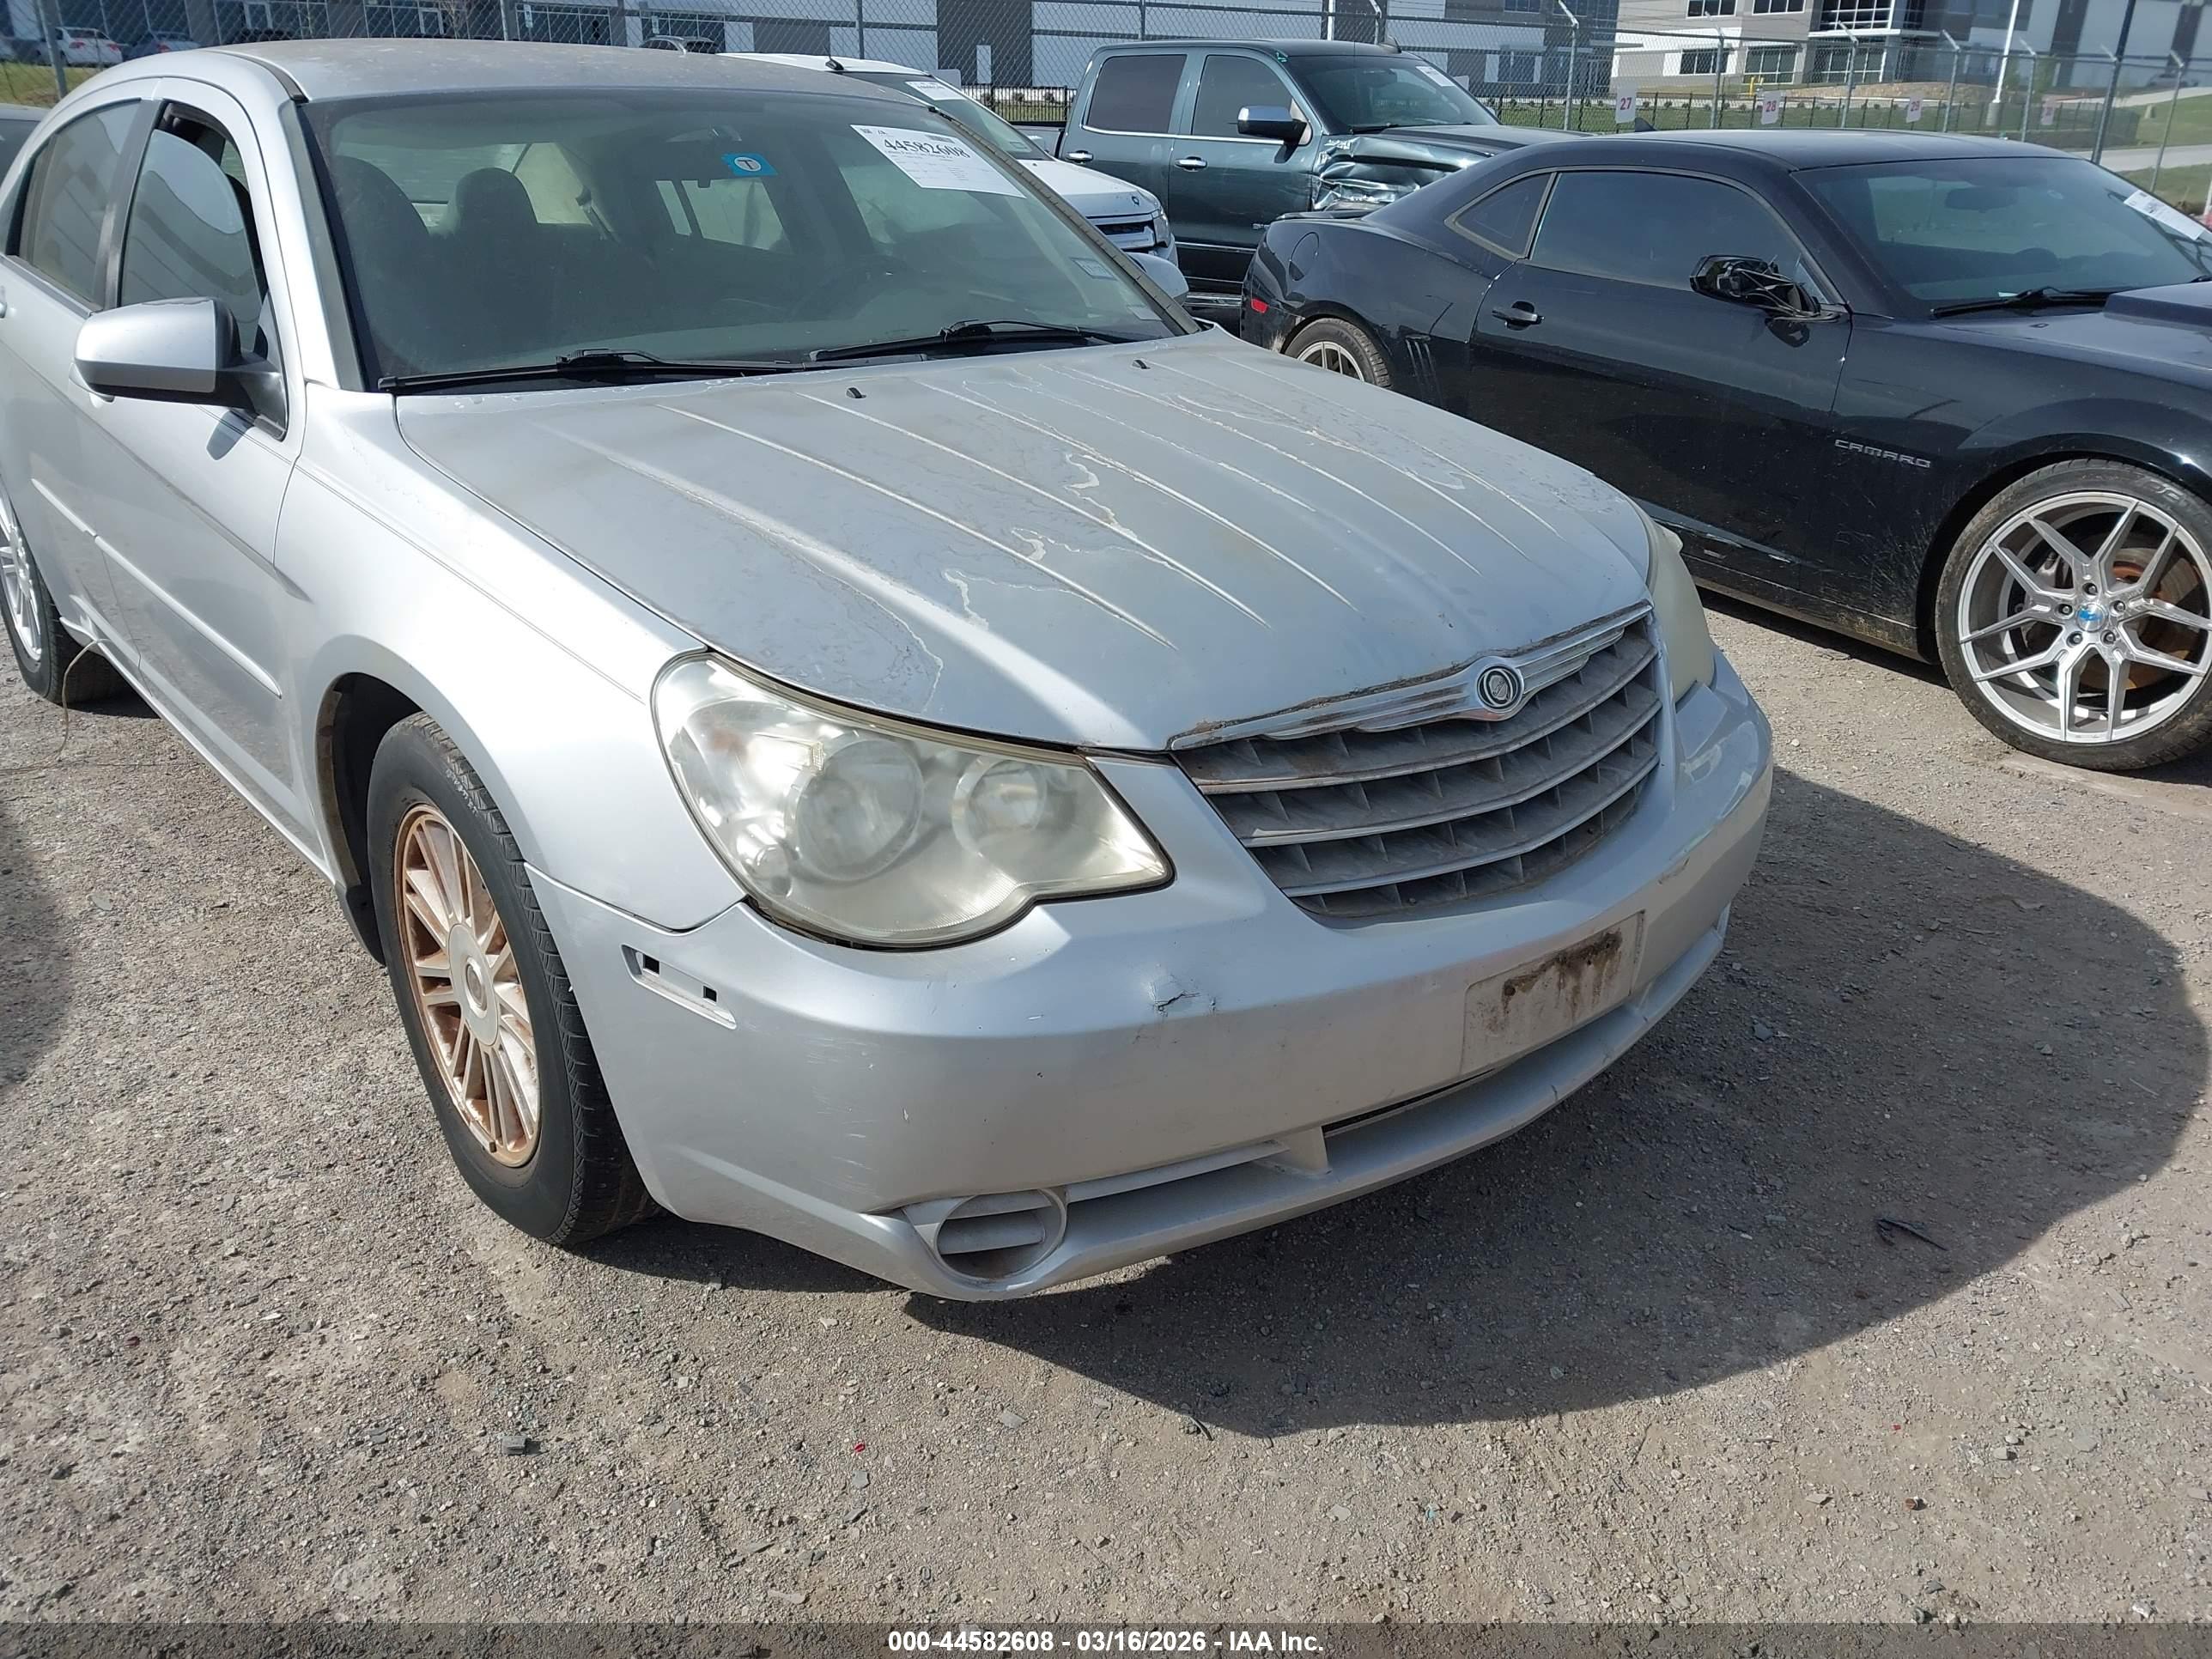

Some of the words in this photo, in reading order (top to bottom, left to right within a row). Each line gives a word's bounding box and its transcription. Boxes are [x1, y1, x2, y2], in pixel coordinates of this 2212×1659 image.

[1620, 97, 1632, 111] 27
[1765, 100, 1777, 112] 28
[884, 138, 971, 159] 44582608
[1834, 439, 1931, 469] CAMARO
